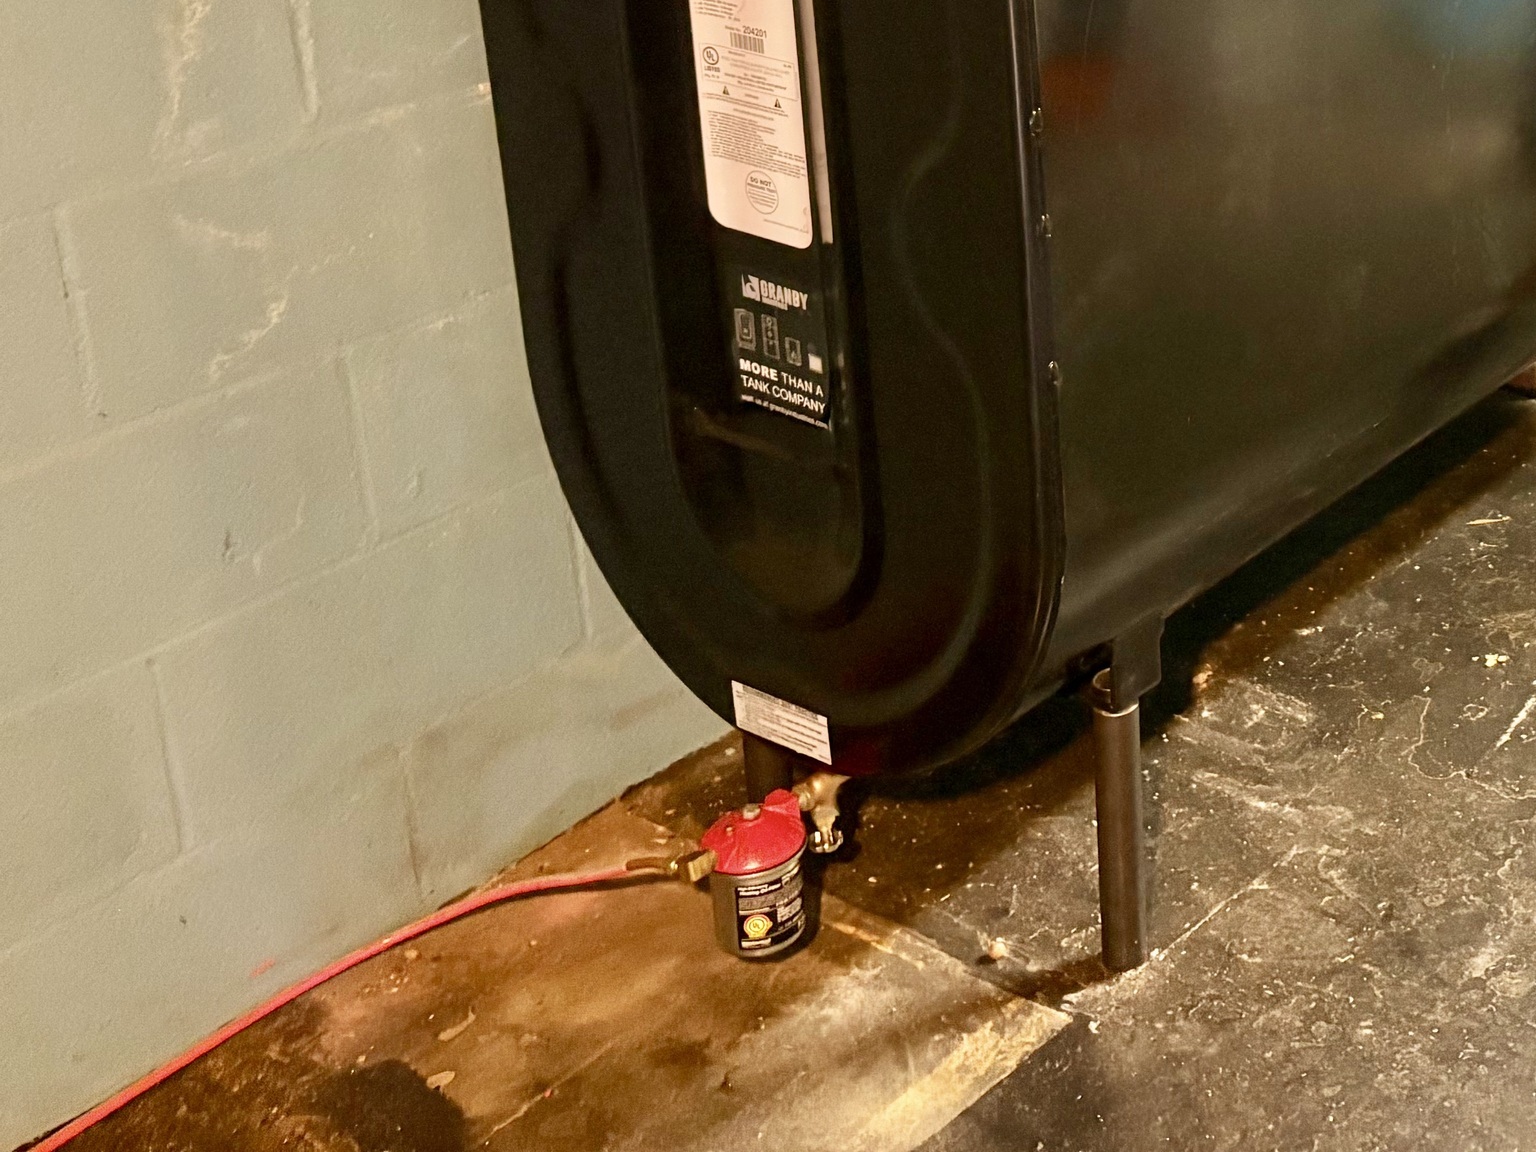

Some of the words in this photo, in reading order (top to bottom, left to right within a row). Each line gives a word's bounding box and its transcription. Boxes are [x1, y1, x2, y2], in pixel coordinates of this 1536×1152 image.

[742, 25, 768, 38] 204201
[760, 279, 809, 311] GRANBY
[739, 358, 779, 381] MORE
[780, 371, 813, 395] THAN
[815, 385, 824, 398] A
[740, 374, 771, 395] TANK
[772, 385, 826, 414] COMPANY
